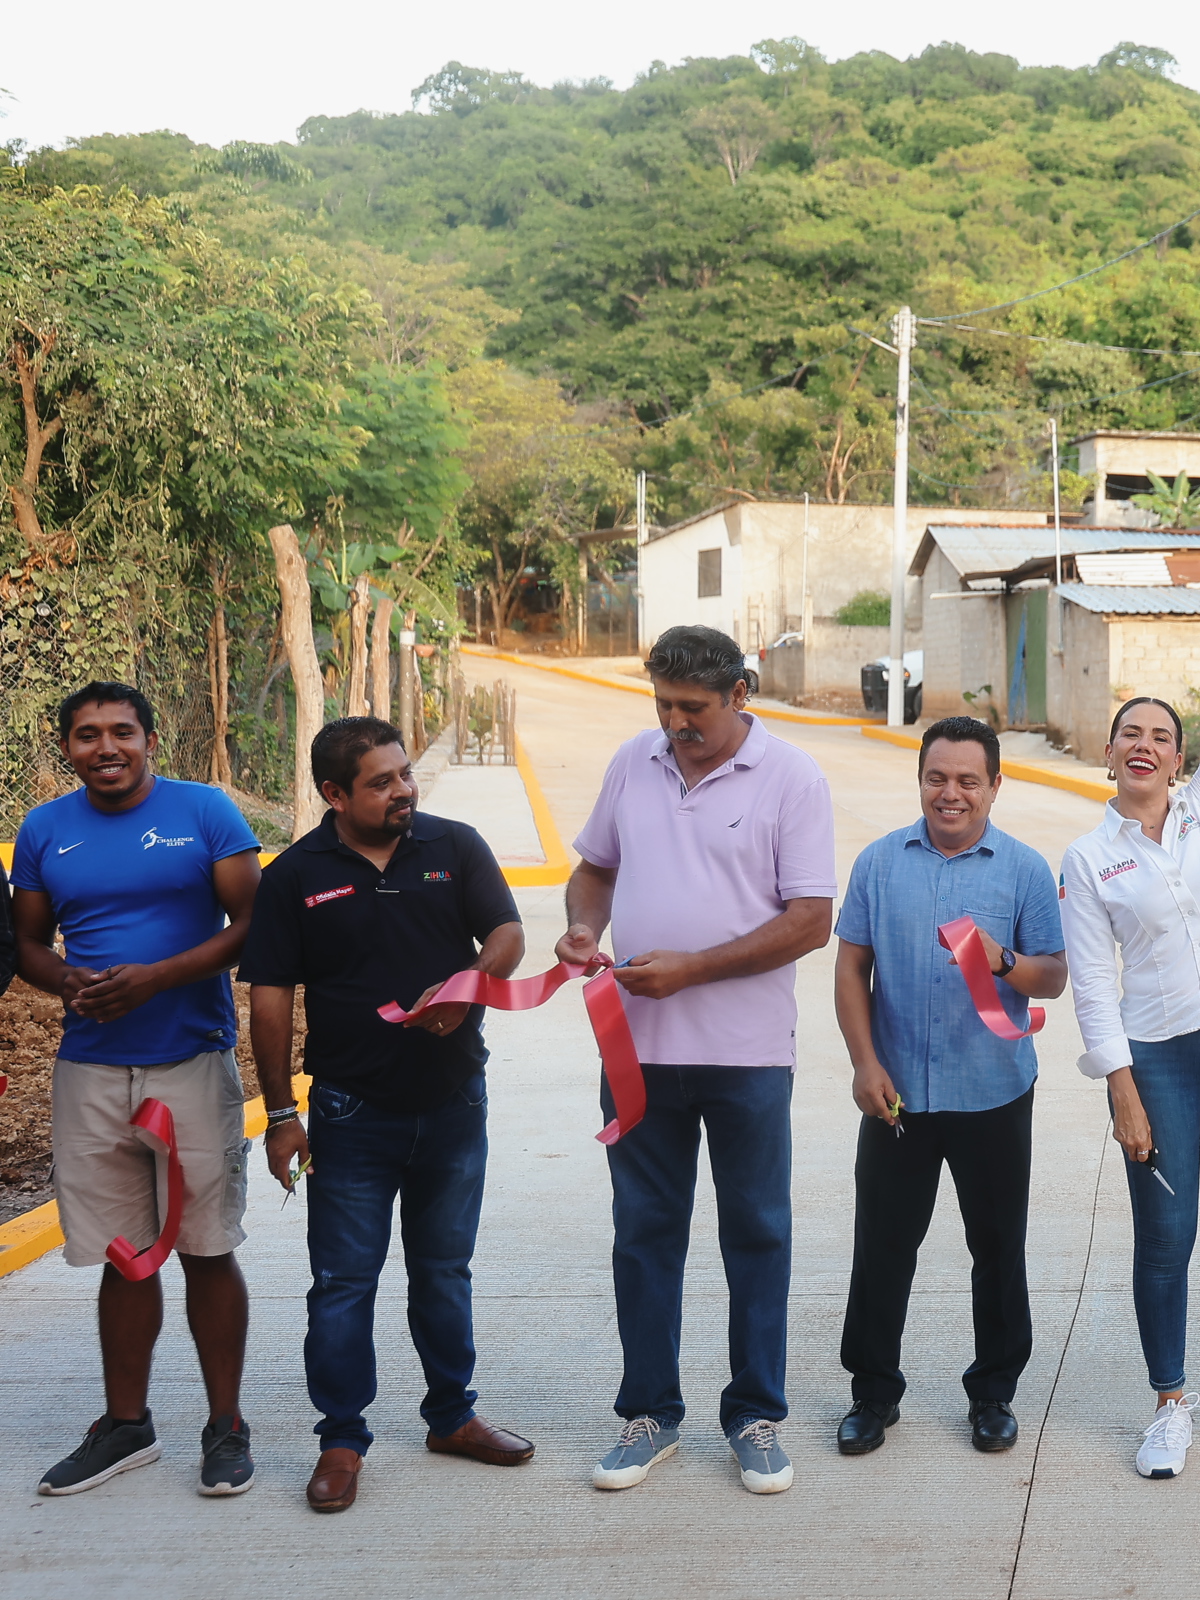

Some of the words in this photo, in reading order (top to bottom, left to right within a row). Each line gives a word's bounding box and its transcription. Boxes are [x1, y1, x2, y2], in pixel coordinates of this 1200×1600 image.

[1098, 866, 1111, 877] LIZ
[1111, 858, 1135, 870] TAPIA
[423, 871, 451, 879] ZIHUA
